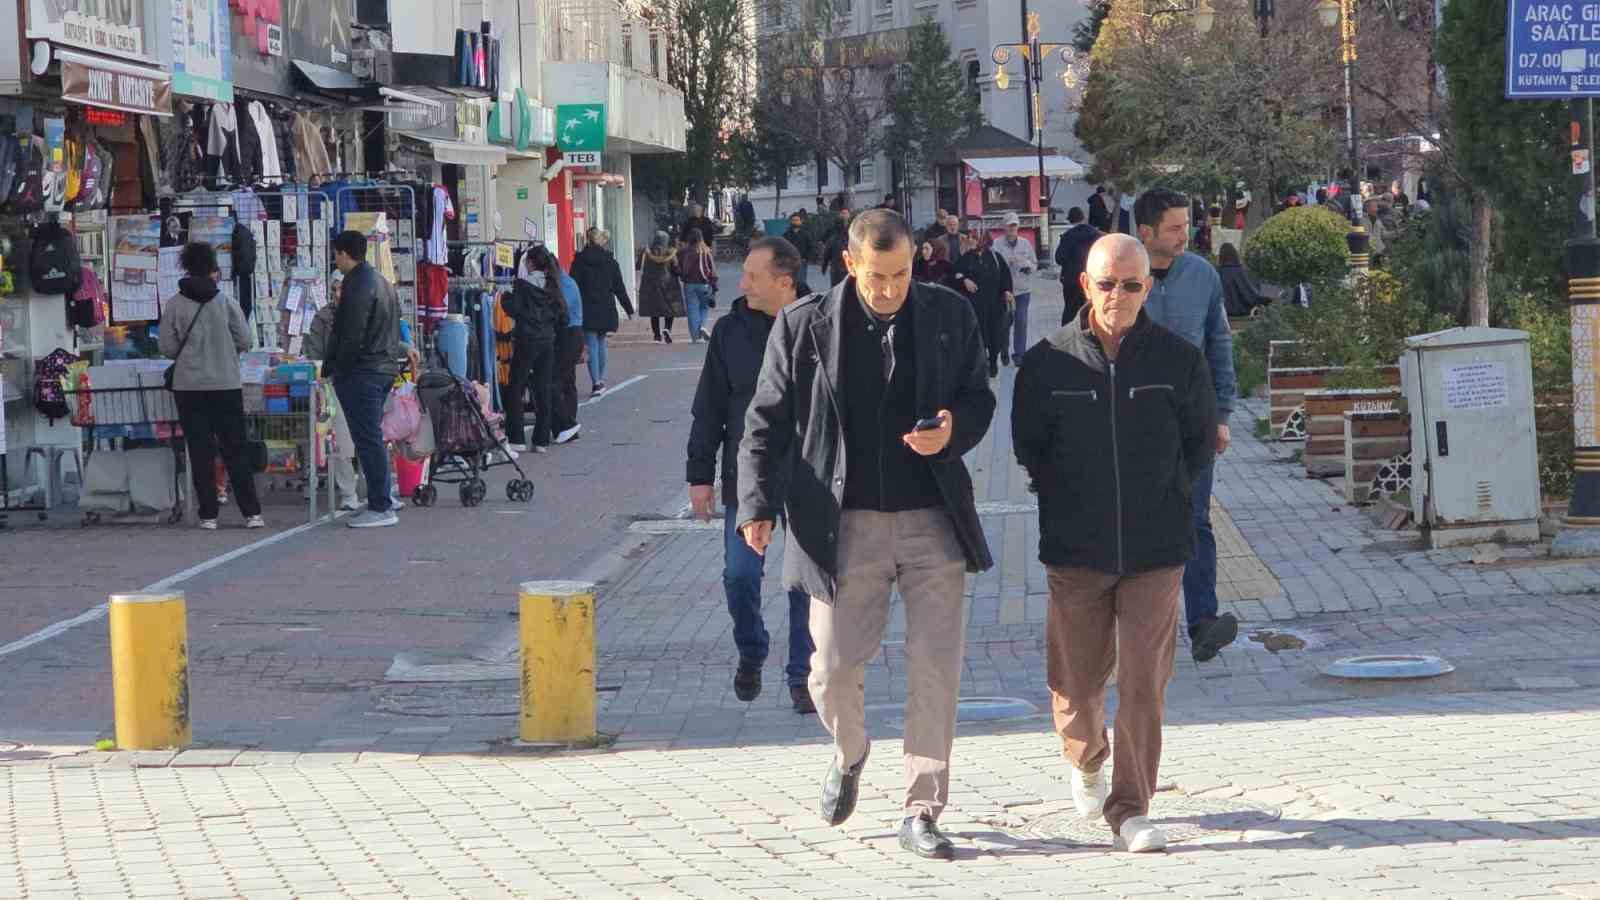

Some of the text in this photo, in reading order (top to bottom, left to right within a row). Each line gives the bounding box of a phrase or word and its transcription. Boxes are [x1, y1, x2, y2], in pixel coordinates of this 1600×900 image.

[1525, 4, 1600, 24] ARAÇ Gİ
[1519, 53, 1561, 68] 07.00
[568, 153, 594, 163] TEB
